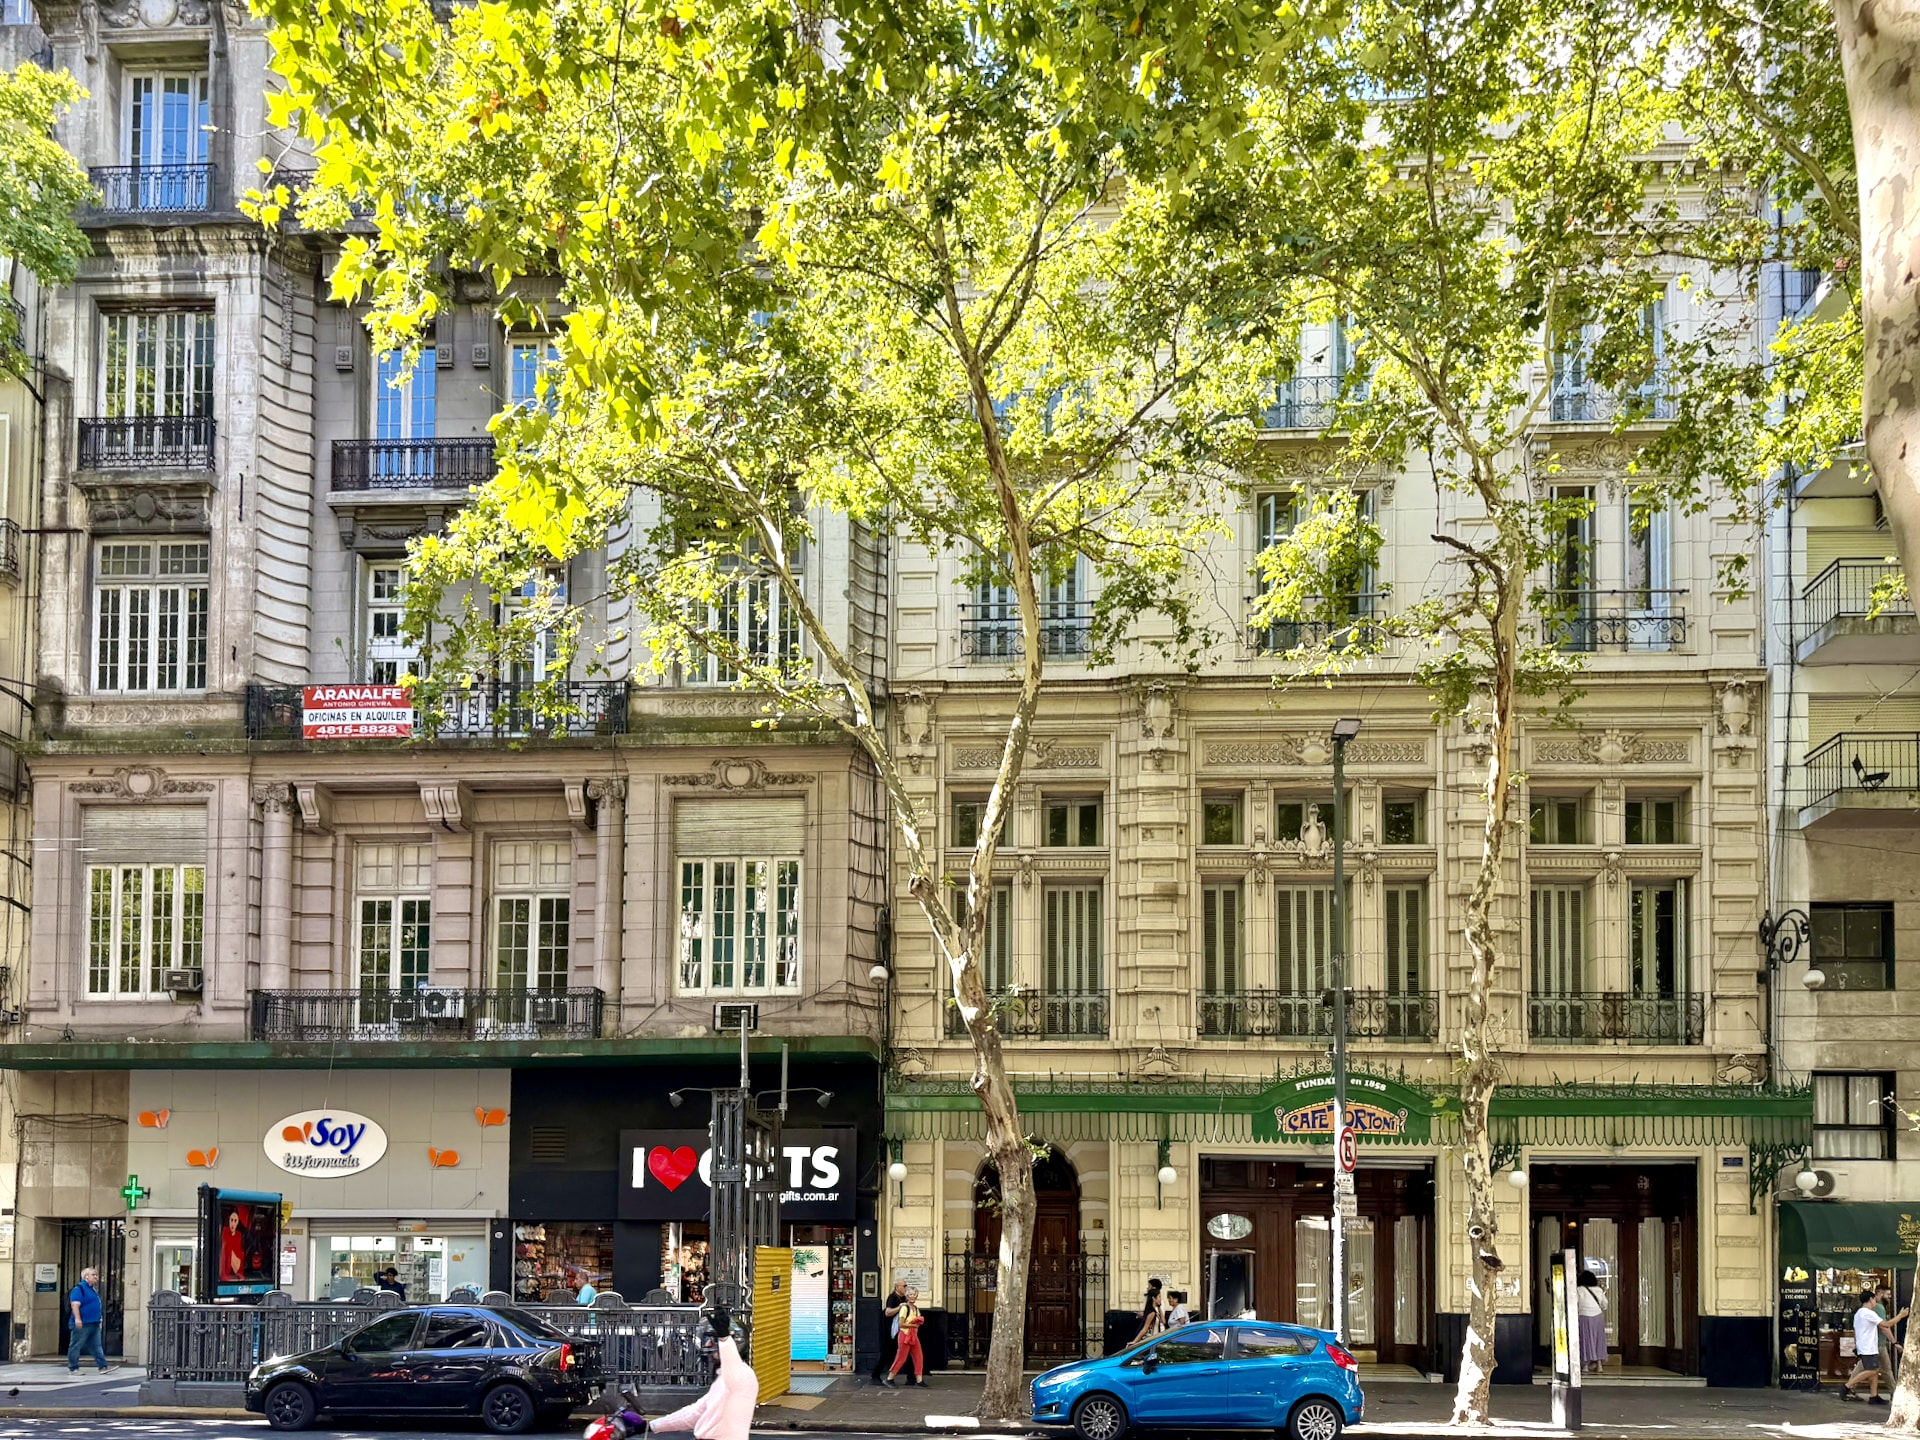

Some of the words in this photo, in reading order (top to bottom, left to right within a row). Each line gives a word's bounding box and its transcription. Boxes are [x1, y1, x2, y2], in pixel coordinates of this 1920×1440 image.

[312, 687, 402, 700] ARANALFE
[308, 712, 347, 722] OFICINAS
[350, 711, 362, 721] EN
[365, 711, 407, 721] ALQUILER
[316, 725, 398, 734] 4815-8828
[1350, 1078, 1362, 1086] en
[1364, 1079, 1387, 1091] 1858
[1327, 1105, 1396, 1131] ORTONI
[310, 1118, 366, 1155] Soy
[283, 1153, 302, 1169] tu
[632, 1147, 645, 1188] I
[1798, 1336, 1818, 1345] ORO
